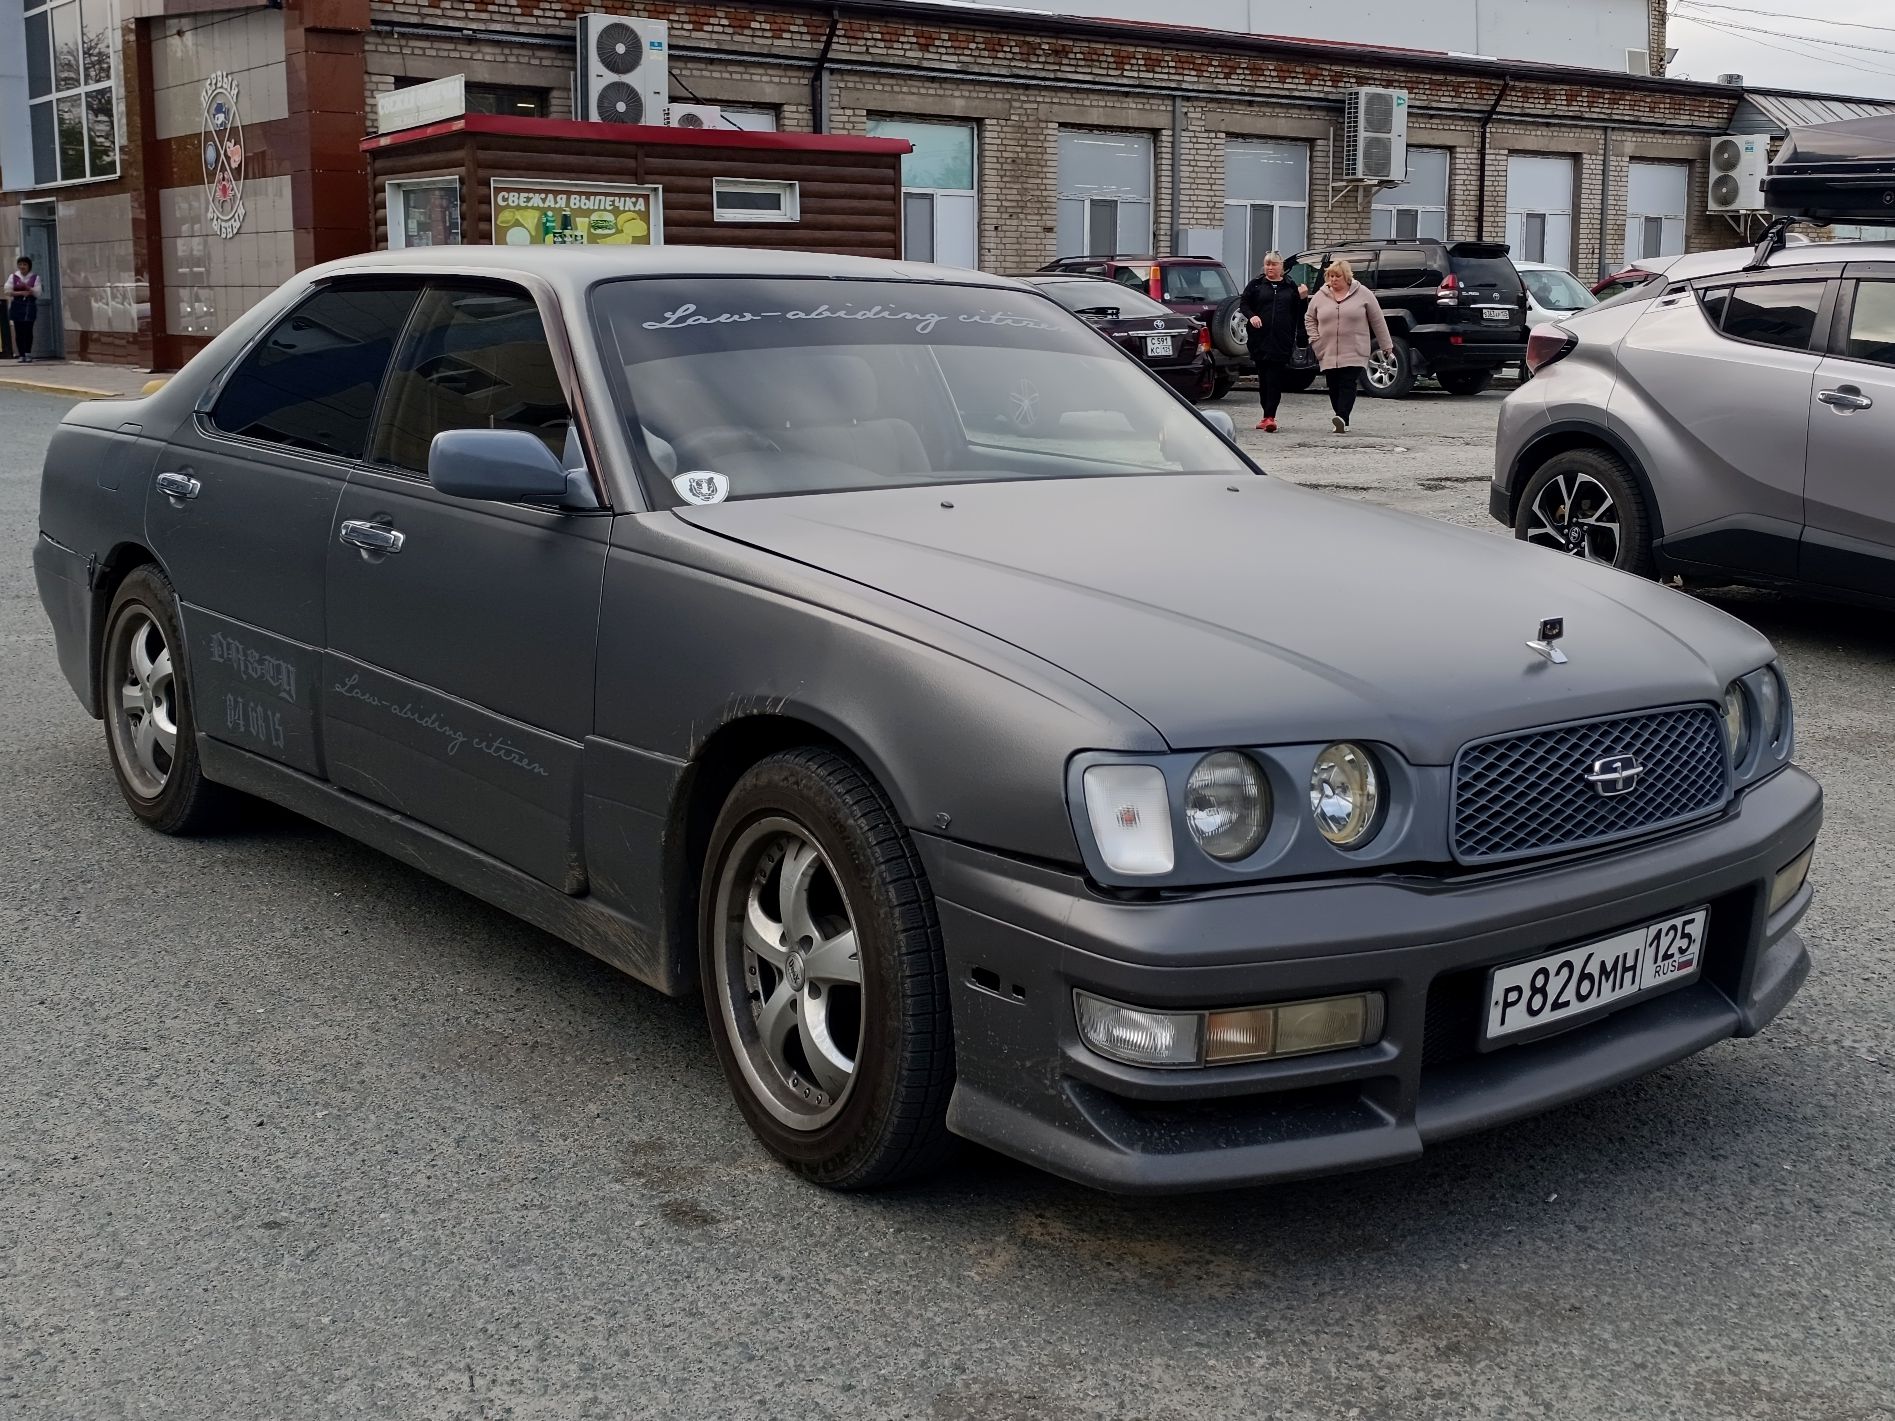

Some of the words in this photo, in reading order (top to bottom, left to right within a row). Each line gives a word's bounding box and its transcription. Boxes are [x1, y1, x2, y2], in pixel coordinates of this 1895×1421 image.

[201, 70, 239, 109] ПЕРВЫЙ
[208, 200, 246, 239] РЫБНЫЙ
[497, 191, 566, 208] СВЕЖАЯ
[570, 195, 646, 212] ВЫПЕЧКА
[1157, 337, 1168, 345] 591
[335, 673, 467, 755] Law-abiding
[473, 732, 549, 776] citizen
[1500, 948, 1640, 1026] Р826МН
[1649, 918, 1696, 965] 125
[1654, 959, 1677, 979] RUS
